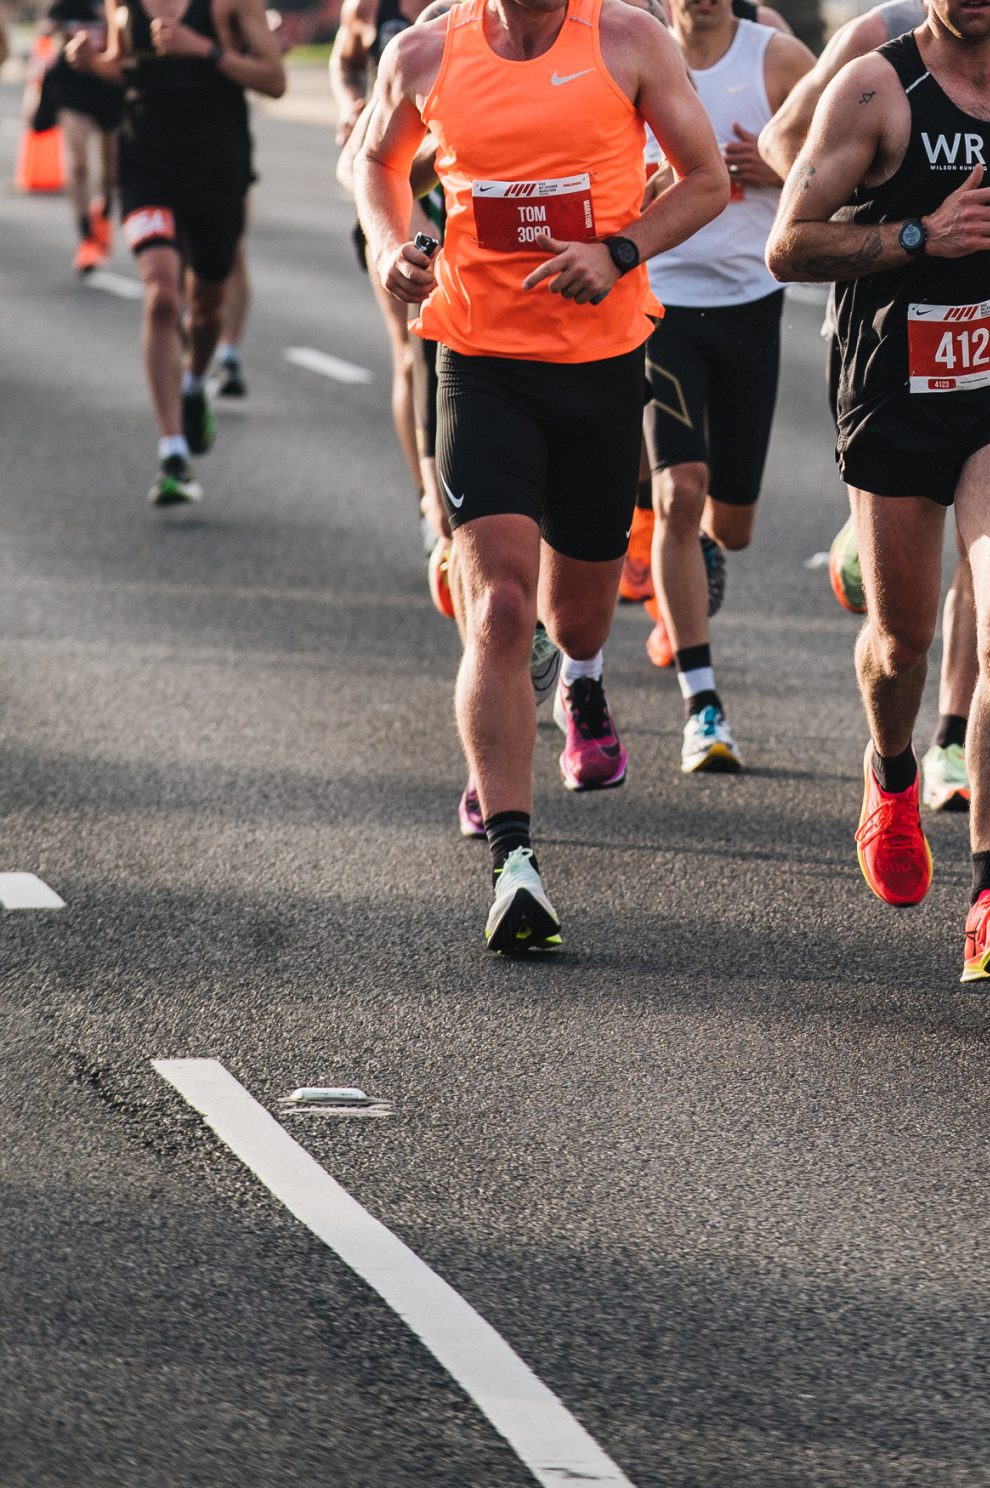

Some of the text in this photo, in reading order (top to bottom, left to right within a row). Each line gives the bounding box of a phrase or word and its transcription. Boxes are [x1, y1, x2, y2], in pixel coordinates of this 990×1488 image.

[921, 132, 987, 165] WR
[517, 205, 547, 223] TOM
[934, 380, 950, 389] 4123
